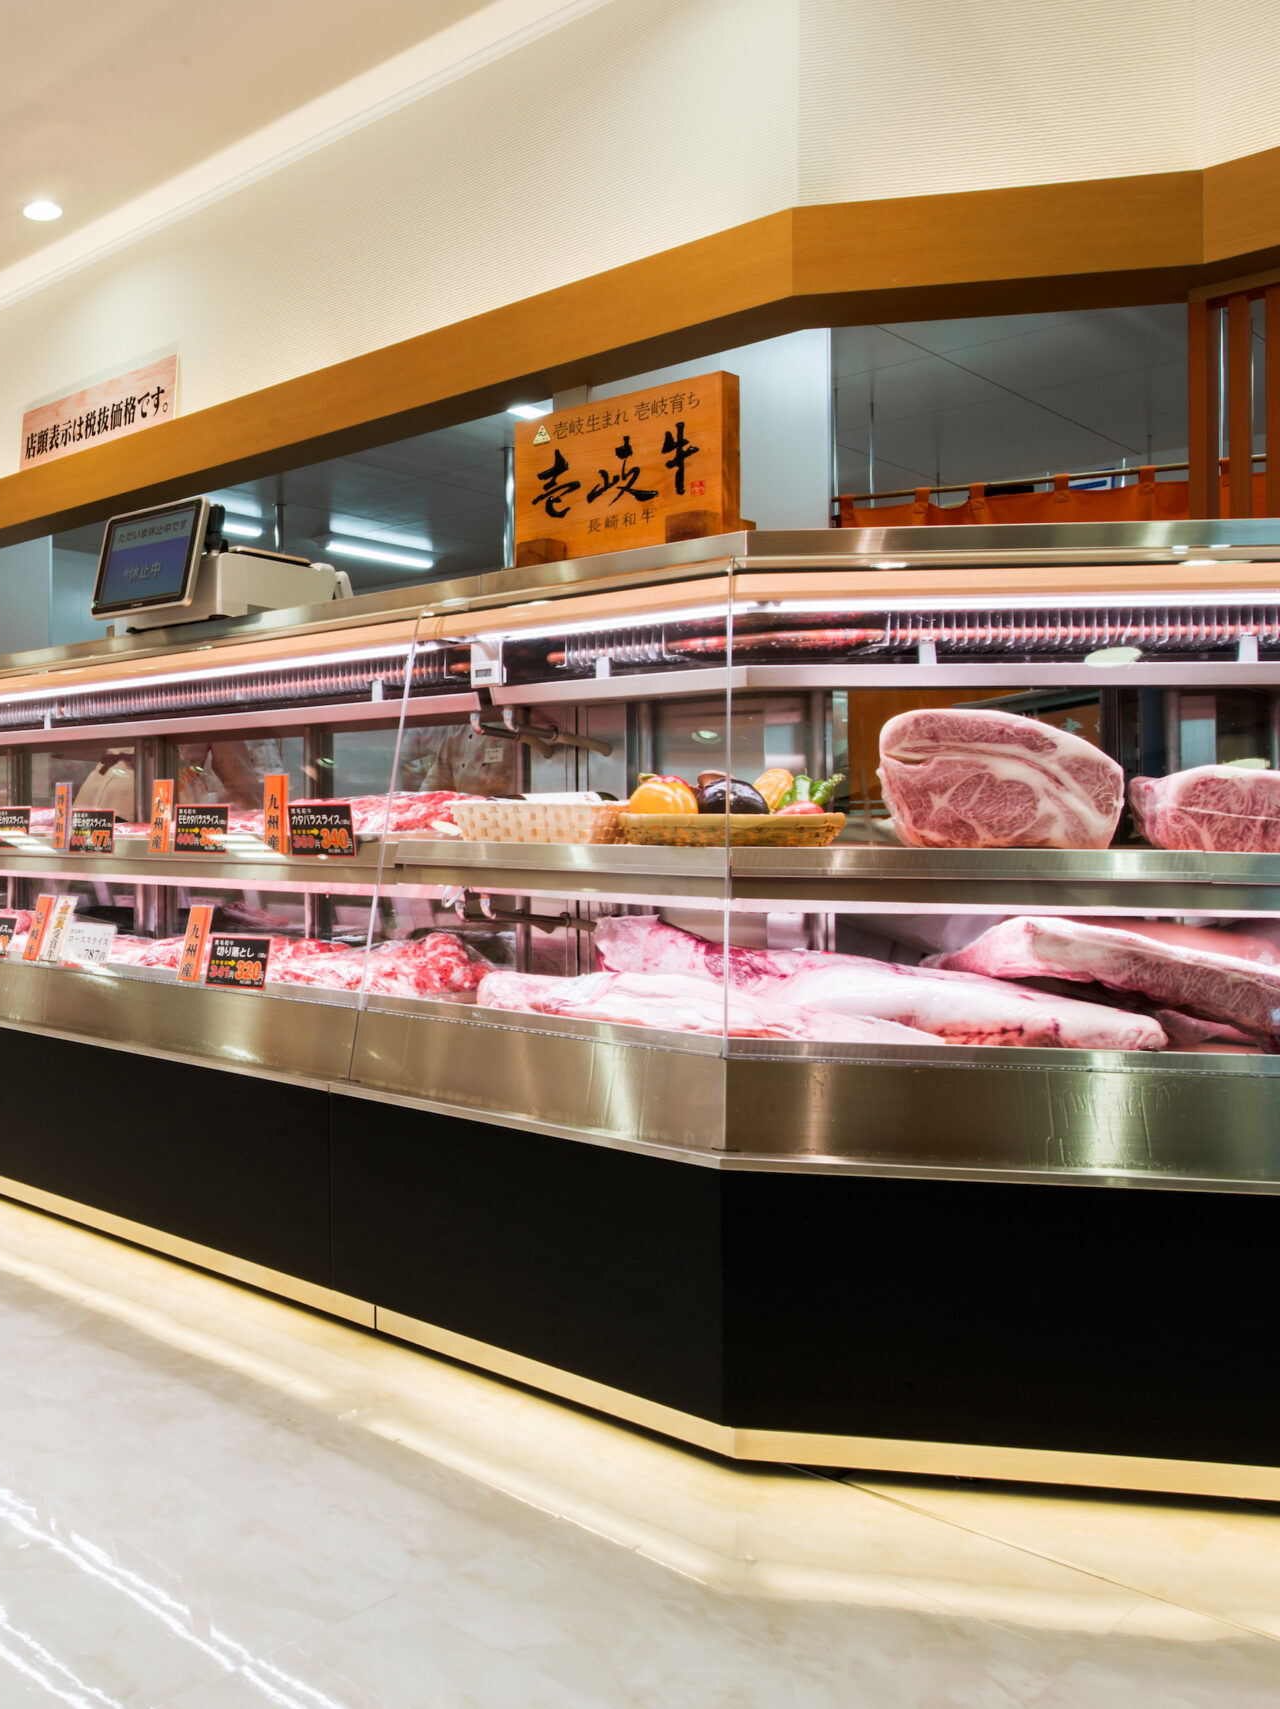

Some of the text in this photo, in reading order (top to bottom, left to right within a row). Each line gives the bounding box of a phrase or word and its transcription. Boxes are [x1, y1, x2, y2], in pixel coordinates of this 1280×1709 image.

[24, 386, 169, 460] 店頭表示は税抜価格です。
[553, 392, 701, 440] 壱岐生まれ 壱岐育ち
[532, 422, 700, 518] 壱岐牛
[587, 509, 655, 534] 長崎和牛
[181, 923, 200, 977] 九州産
[216, 947, 255, 958] 切り落とし
